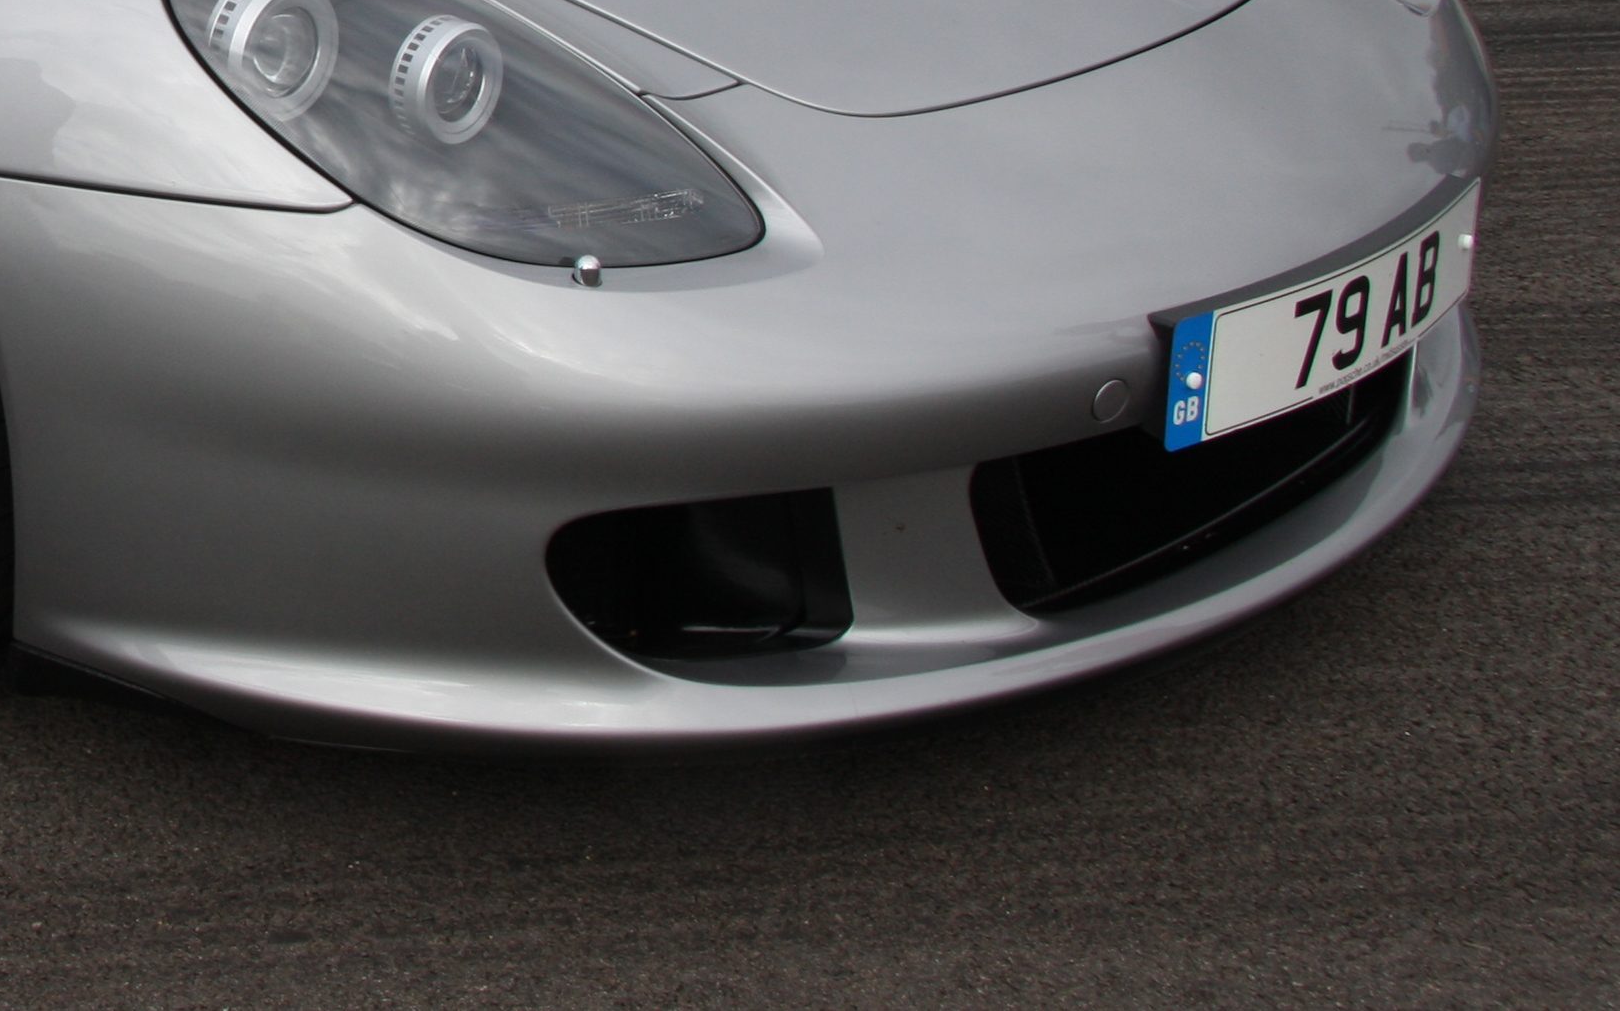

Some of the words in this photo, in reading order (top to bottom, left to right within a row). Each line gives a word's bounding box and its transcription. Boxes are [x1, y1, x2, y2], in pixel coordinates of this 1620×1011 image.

[1294, 275, 1370, 390] 79
[1380, 230, 1440, 349] AB
[1172, 395, 1200, 426] GB
